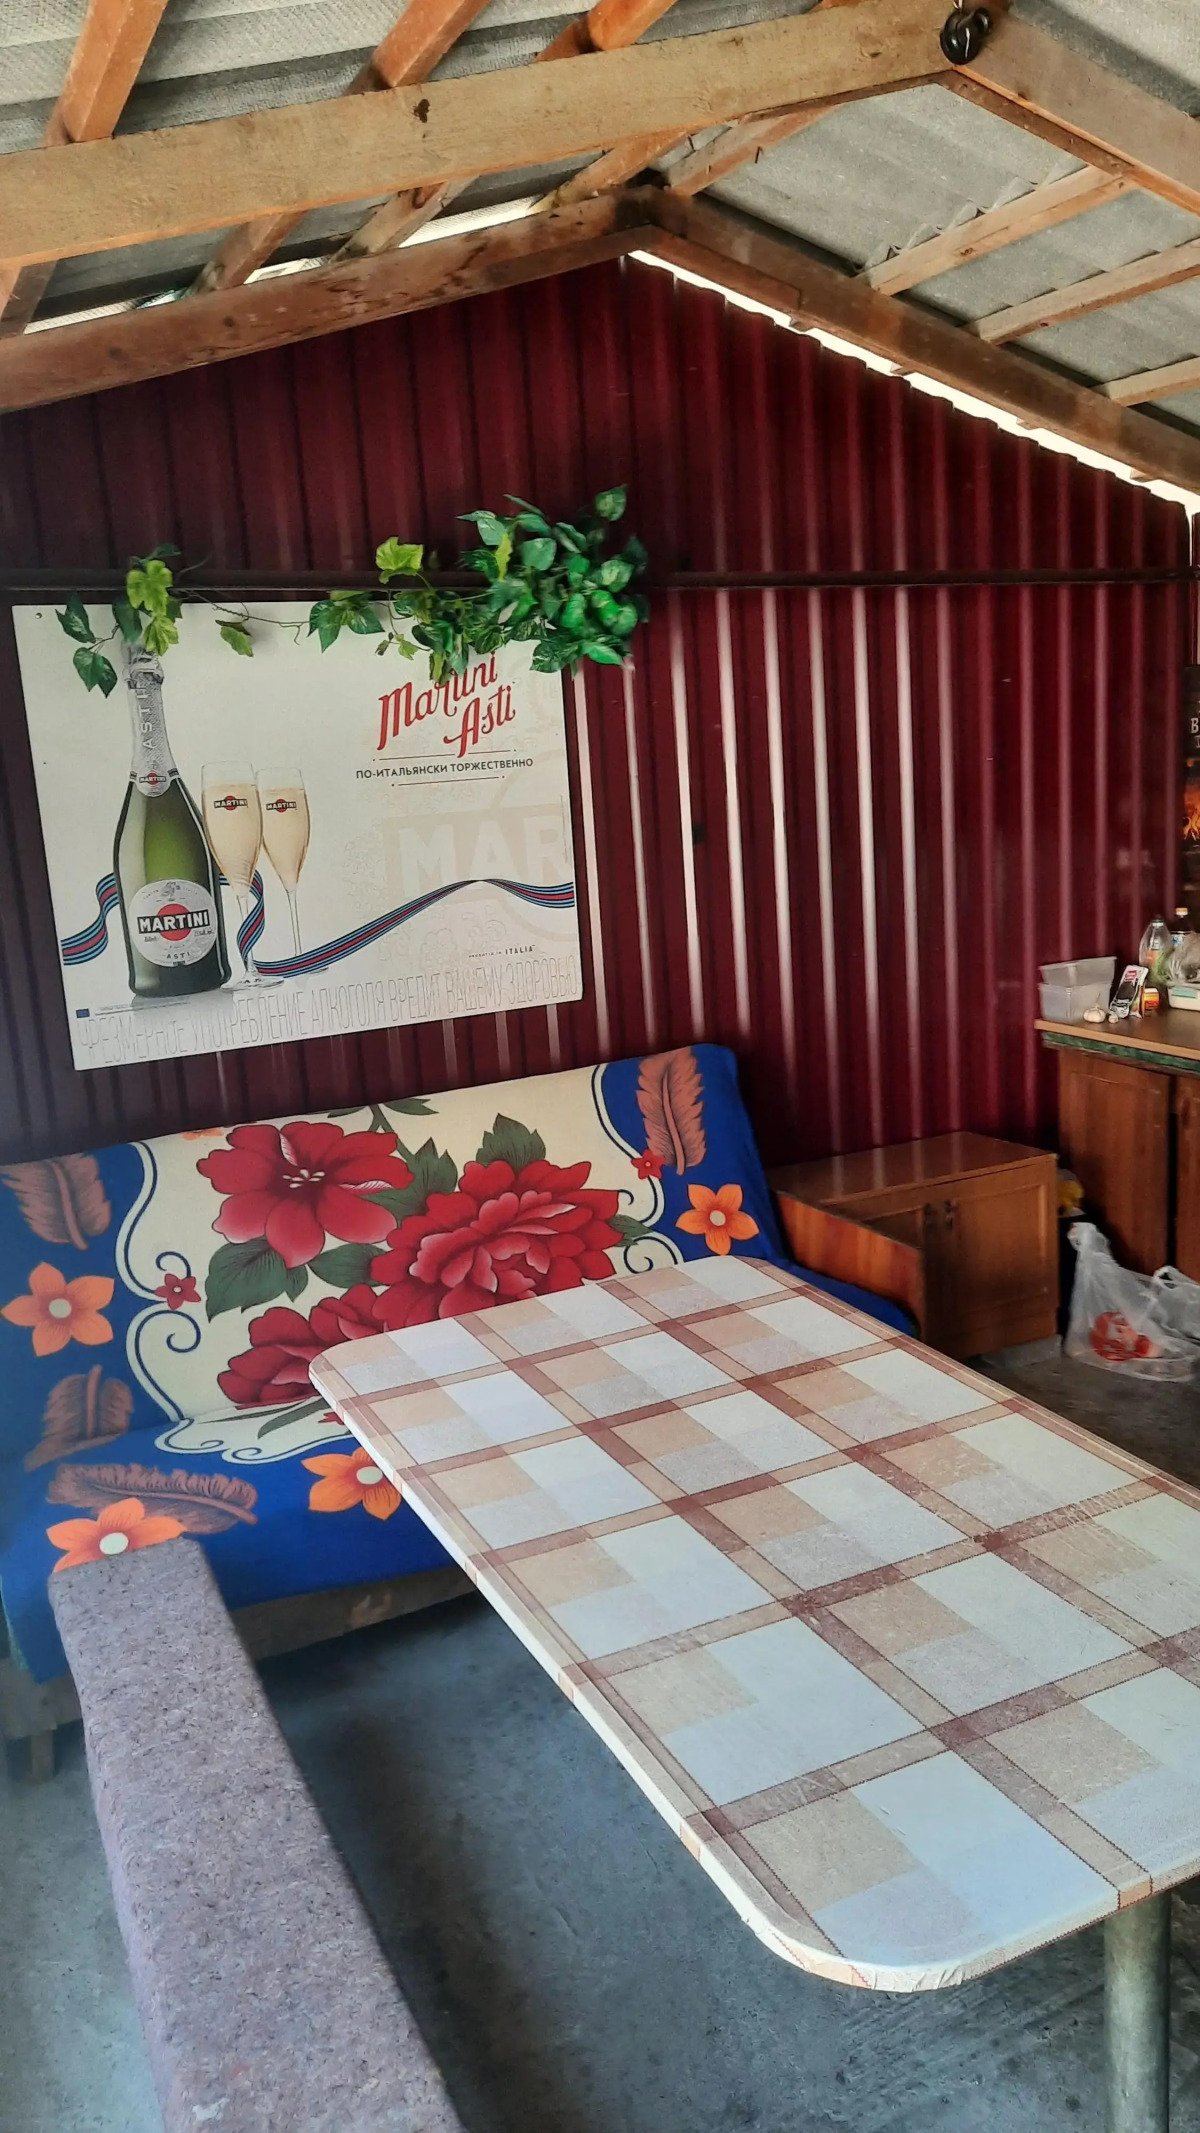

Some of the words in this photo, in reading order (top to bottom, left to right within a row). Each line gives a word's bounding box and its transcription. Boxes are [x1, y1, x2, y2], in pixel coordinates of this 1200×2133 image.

[443, 685, 516, 758] Asti
[356, 764, 448, 779] ПО-ИТАЛЬЯНСКИ
[451, 758, 534, 772] ТОРЖЕСТВЕННО
[214, 799, 248, 808] MARTINI
[266, 802, 297, 810] MARTINI
[139, 911, 210, 933] MARTINI
[166, 951, 191, 960] ASTI
[505, 945, 533, 955] ITALIA
[311, 980, 387, 1031] АЛКОГОЛЯ
[506, 955, 578, 1005] ЗДОРОВЬЮ
